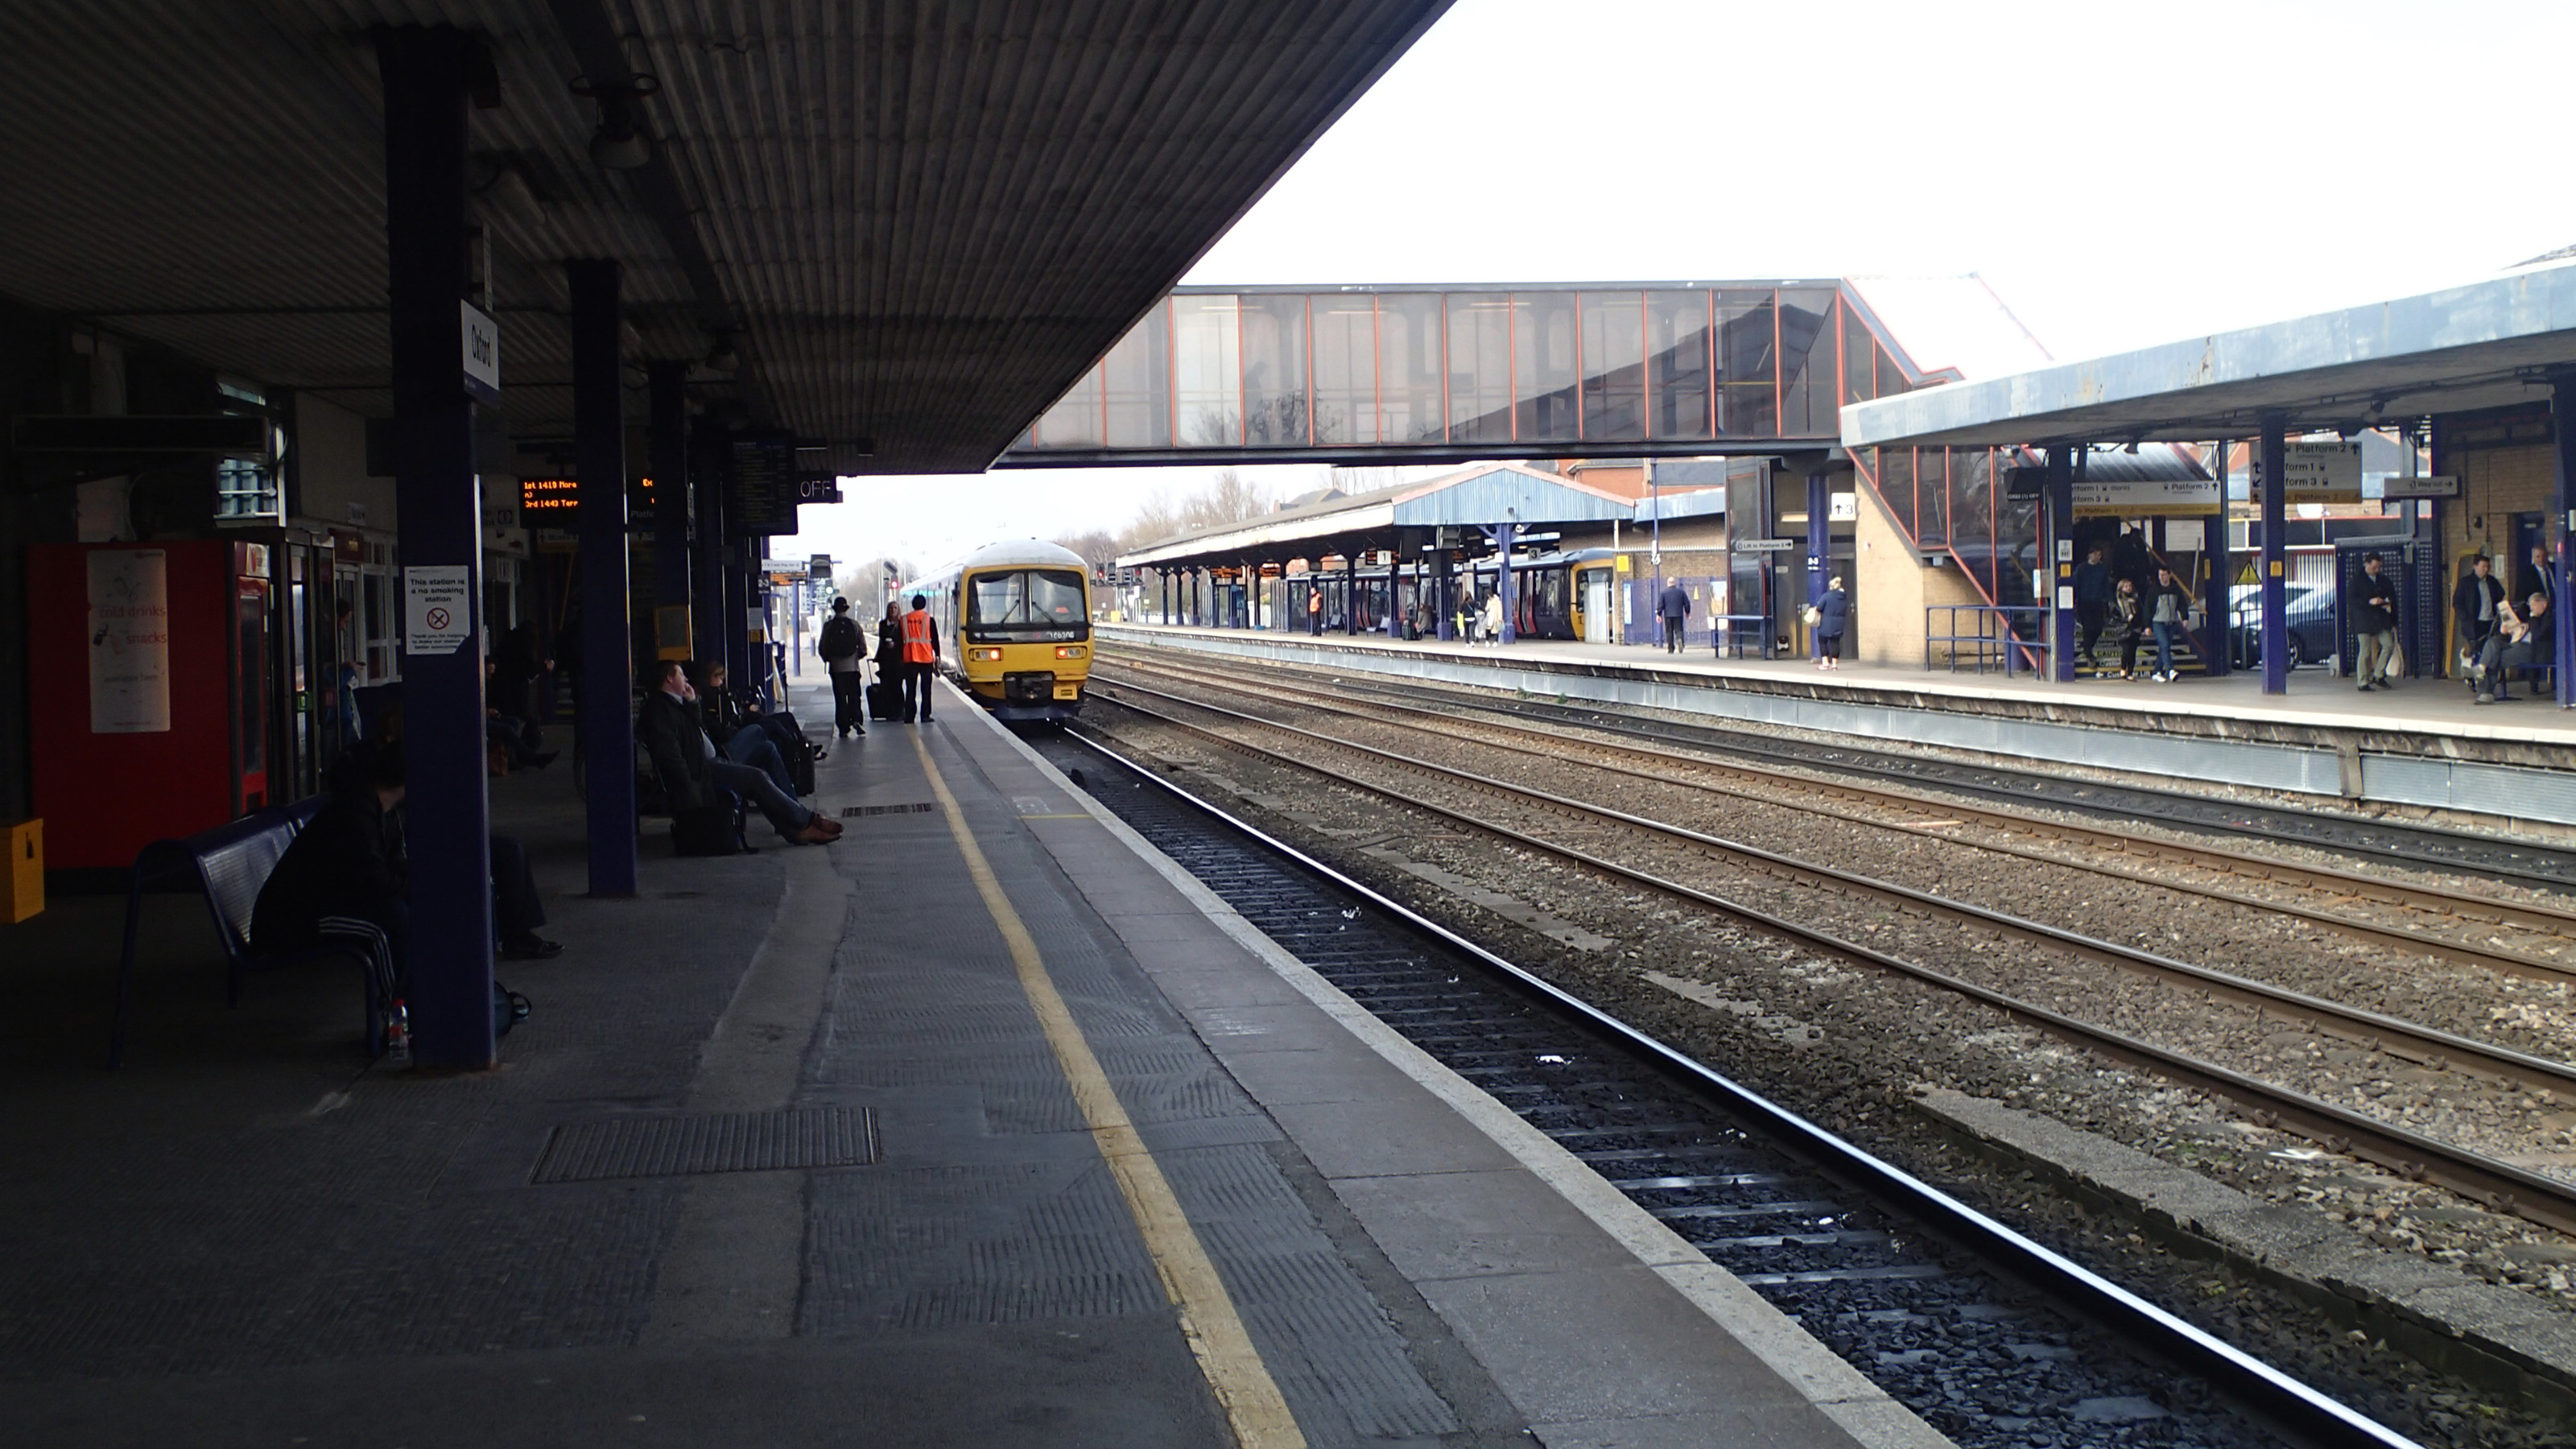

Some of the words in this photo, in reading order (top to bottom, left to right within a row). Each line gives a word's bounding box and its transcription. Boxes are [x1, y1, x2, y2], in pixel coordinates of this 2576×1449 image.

[472, 324, 490, 367] Oxford
[2296, 444, 2338, 453] Platform
[2340, 444, 2346, 452] 2
[2285, 463, 2308, 471] form
[2285, 477, 2308, 486] form
[2310, 477, 2317, 485] 3
[799, 481, 831, 497] OFF
[1846, 505, 1854, 514] 3
[1531, 550, 1538, 559] 3
[100, 606, 124, 618] cold
[129, 605, 166, 617] drinks
[126, 632, 167, 645] snacks
